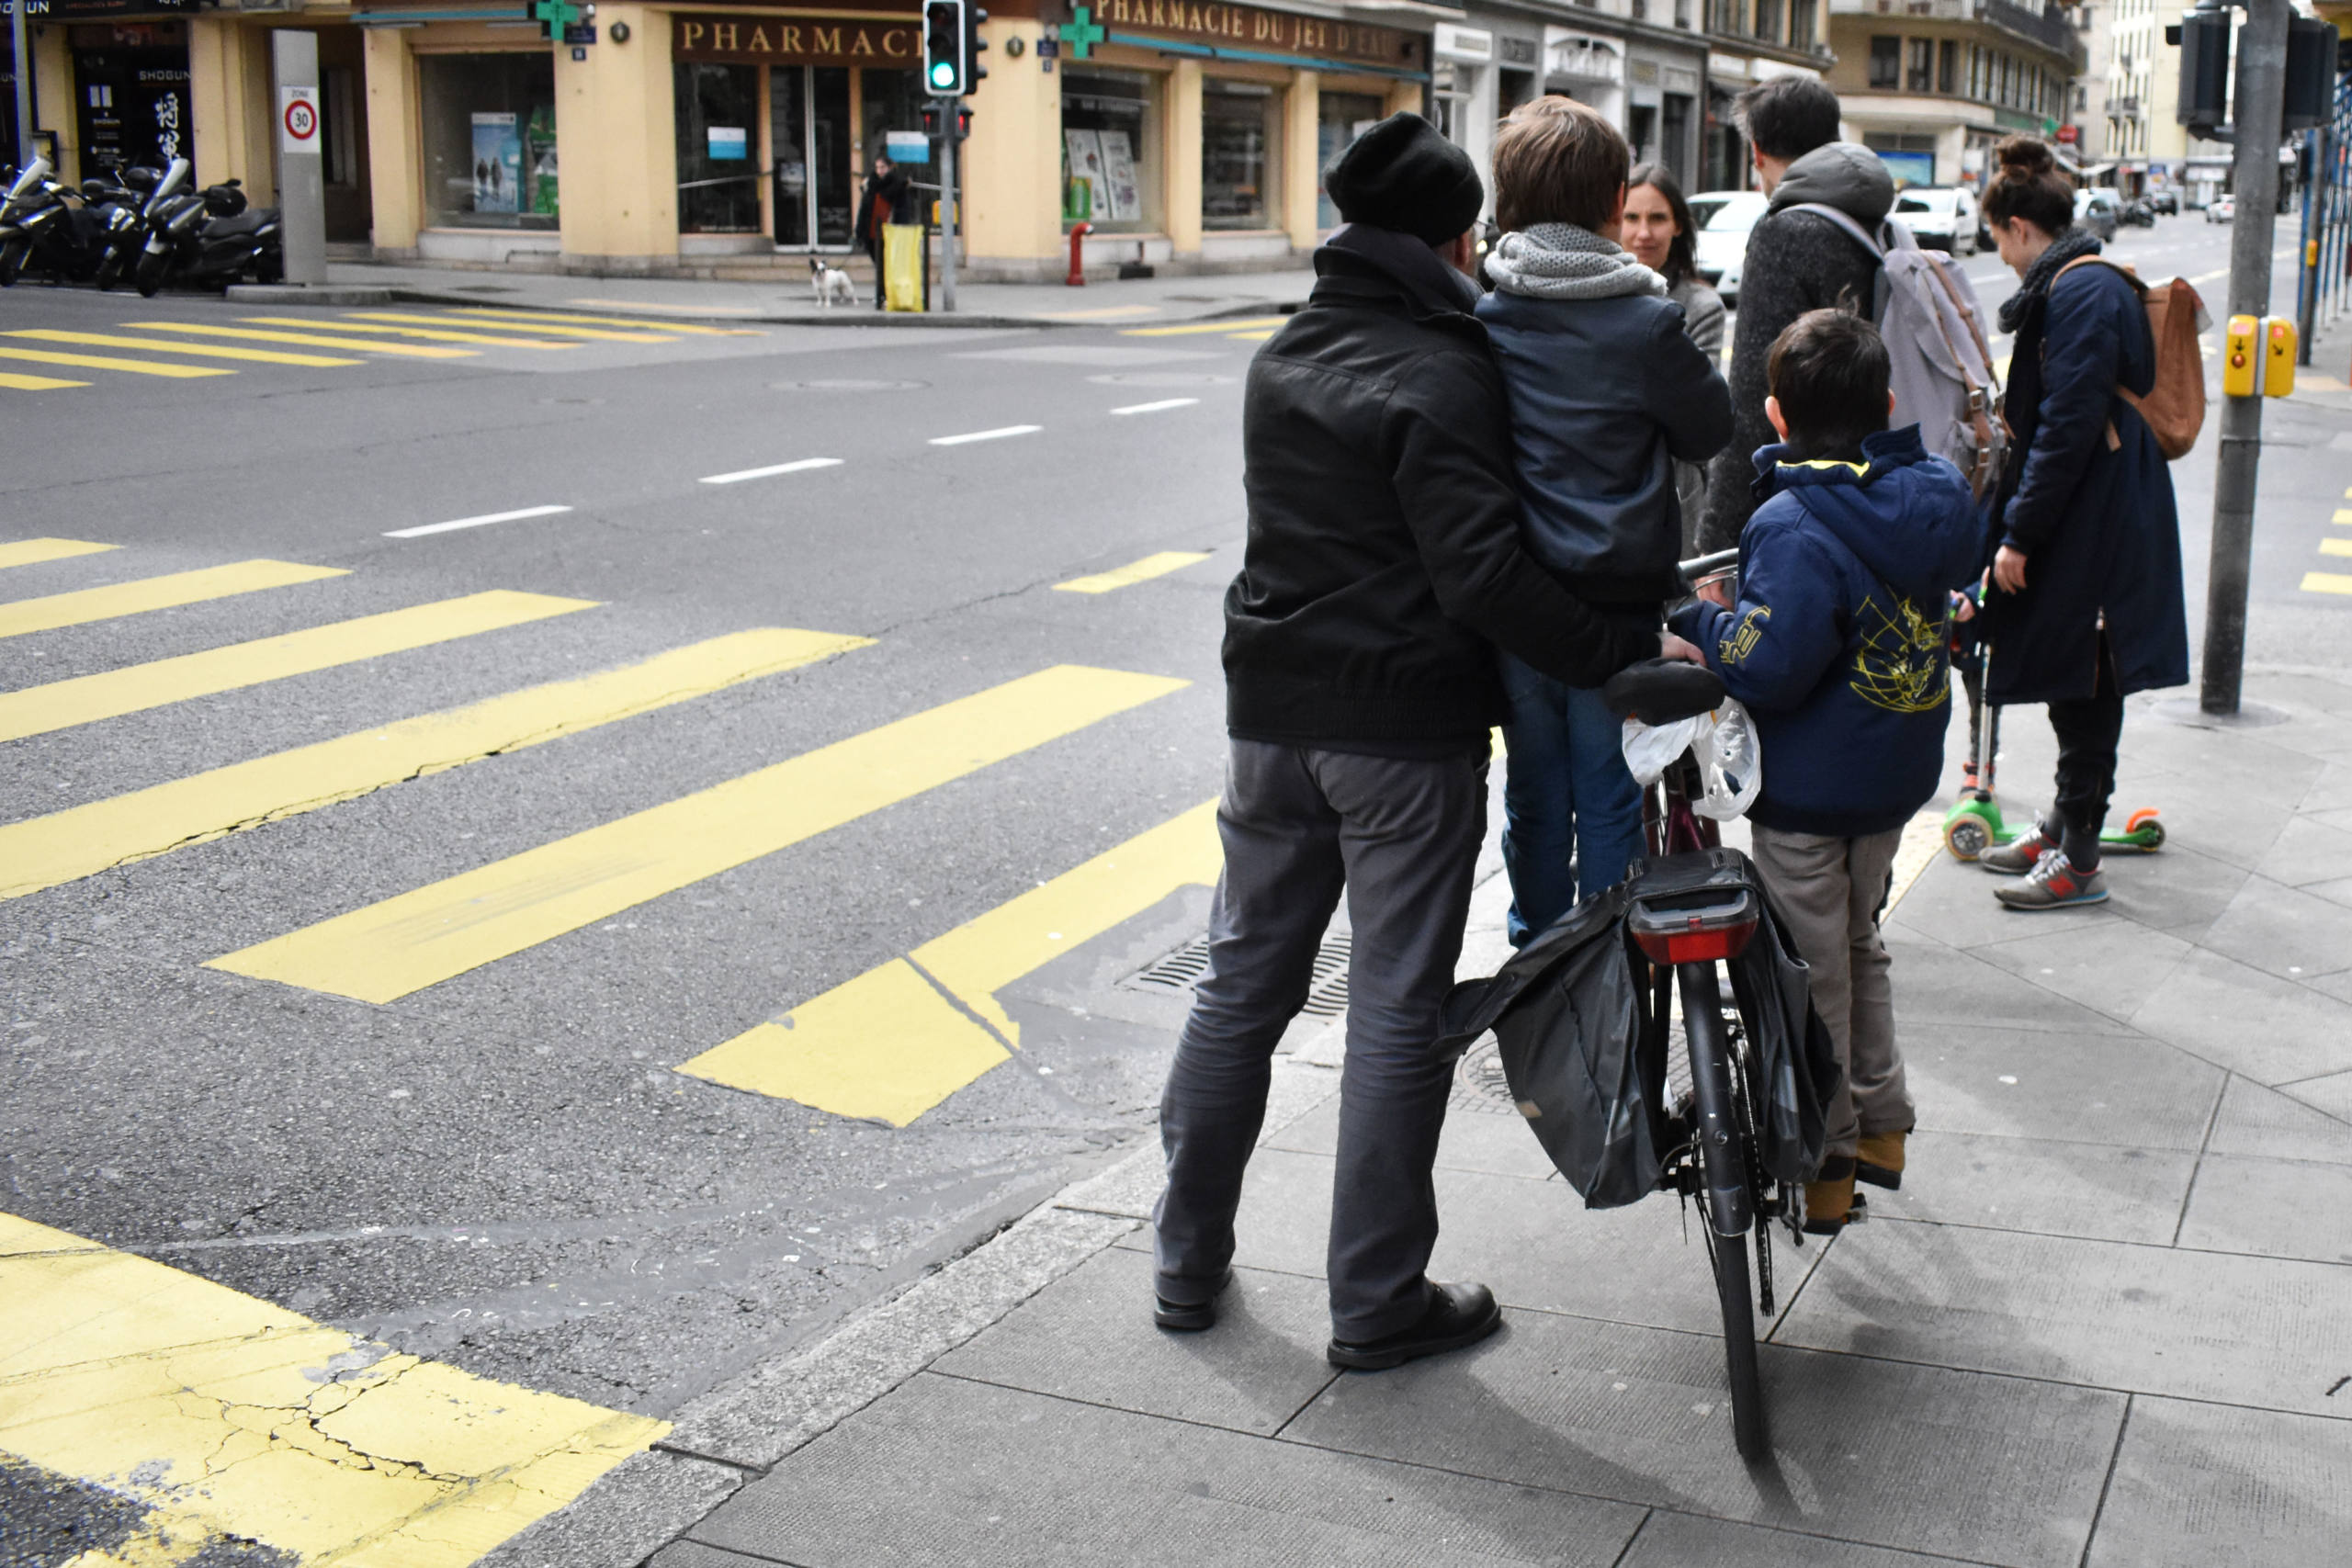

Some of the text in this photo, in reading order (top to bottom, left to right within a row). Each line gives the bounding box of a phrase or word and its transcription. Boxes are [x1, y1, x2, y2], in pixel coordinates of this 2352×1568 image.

[1096, 0, 1244, 38] PHARMACIE
[1254, 12, 1284, 43] DU
[1292, 17, 1328, 51] JET
[682, 22, 923, 57] PHARMACI
[140, 70, 191, 81] SHOGUN
[296, 112, 309, 128] 30
